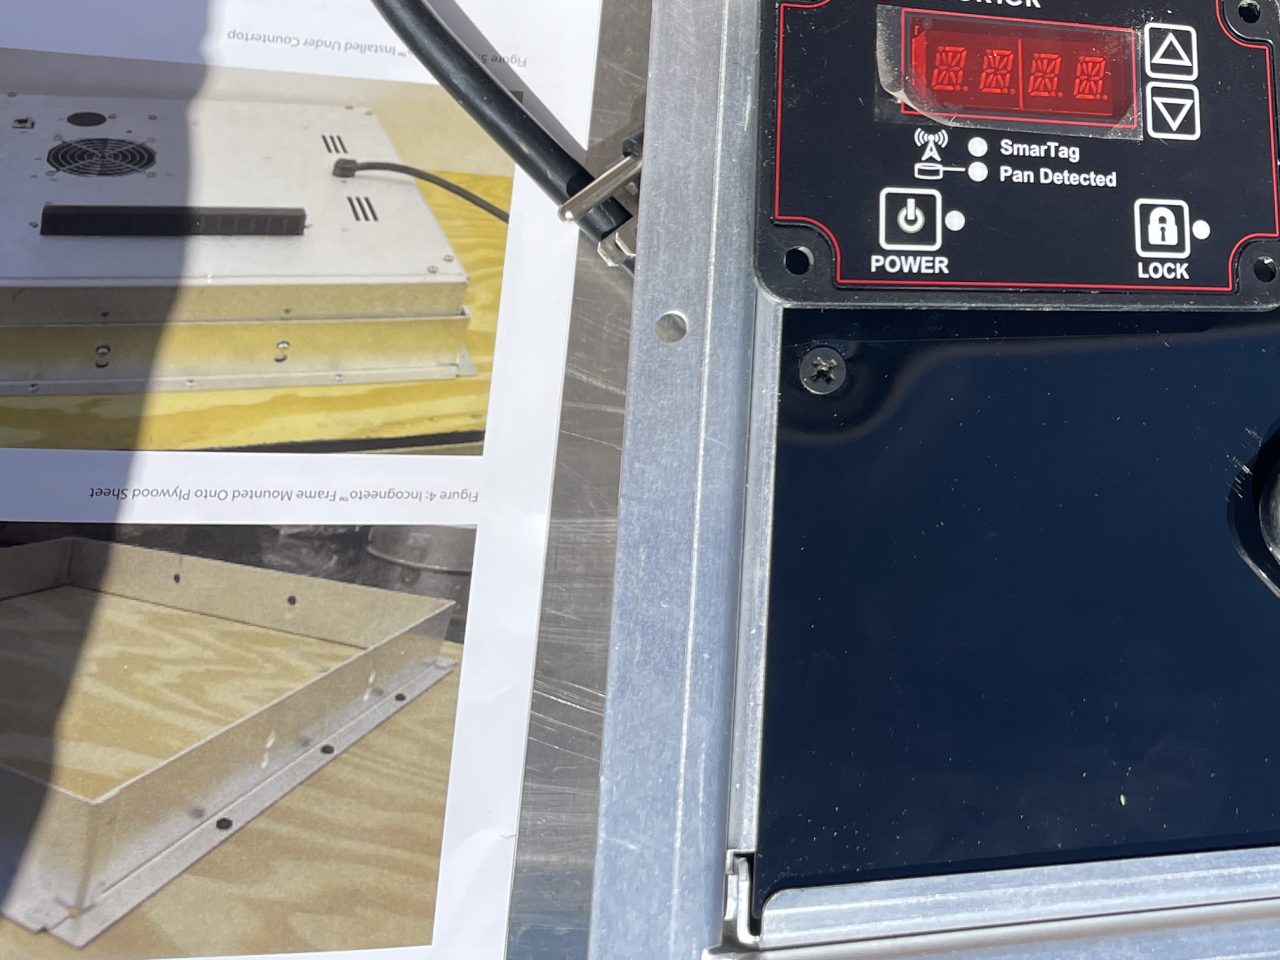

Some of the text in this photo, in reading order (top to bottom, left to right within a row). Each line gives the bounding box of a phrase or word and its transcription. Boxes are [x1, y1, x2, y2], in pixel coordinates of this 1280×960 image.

[227, 30, 301, 48] Countertop
[302, 37, 342, 51] Under
[344, 42, 396, 56] Installed
[1000, 138, 1080, 163] SmarTag
[1000, 165, 1117, 187] Pan Detected
[870, 255, 949, 275] POWER
[1137, 262, 1189, 280] LOCK
[89, 487, 128, 500] Sheet
[132, 486, 190, 501] Plywood
[194, 489, 228, 501] Onto
[232, 489, 293, 501] Mounted
[296, 490, 337, 502] Frame
[426, 490, 437, 501] 4:
[439, 490, 479, 503] Figure
